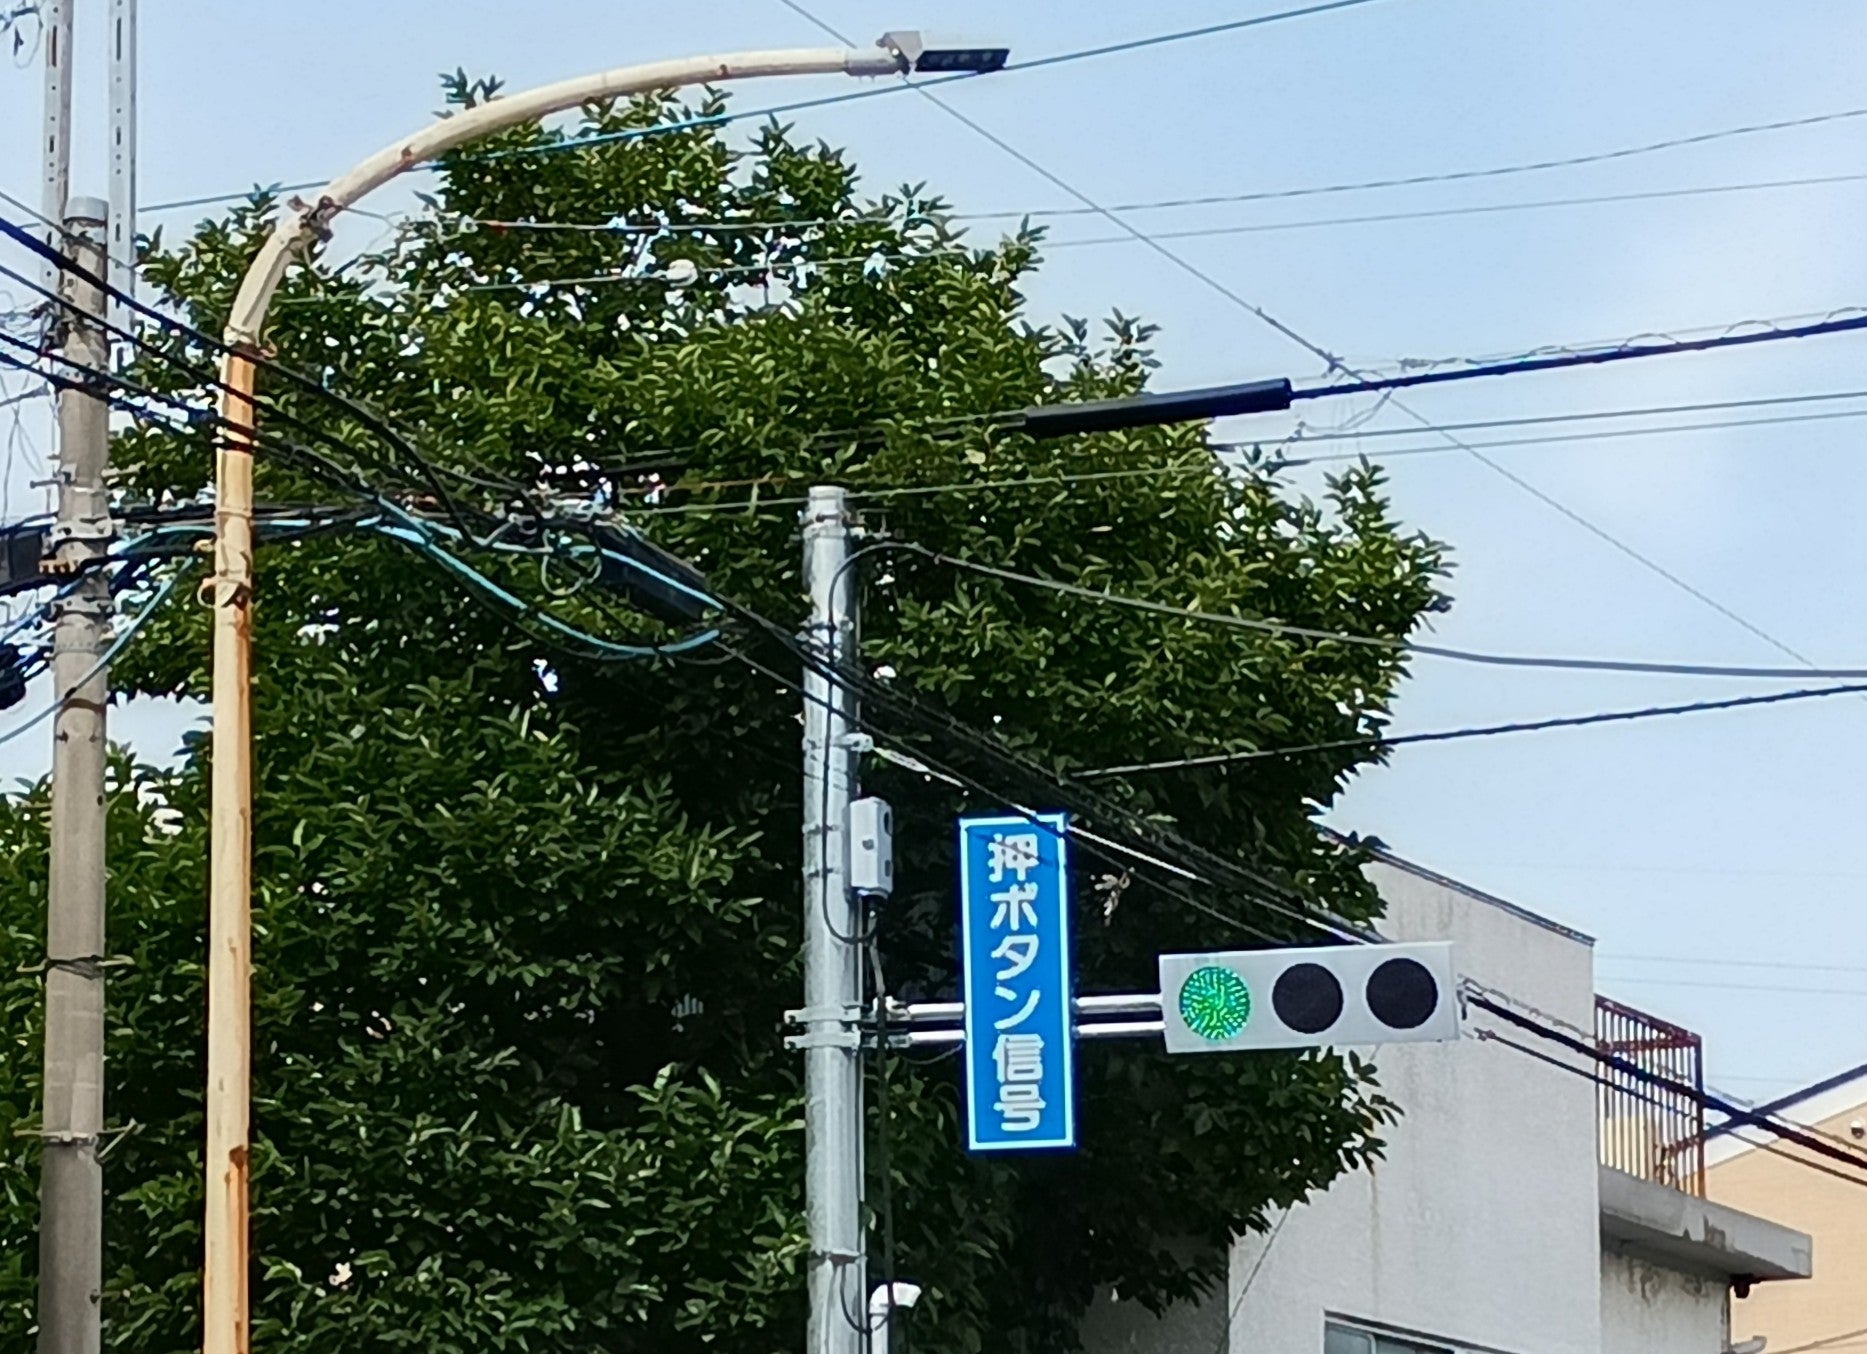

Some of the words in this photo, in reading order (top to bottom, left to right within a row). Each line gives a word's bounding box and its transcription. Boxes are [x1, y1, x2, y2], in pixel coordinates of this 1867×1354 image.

[988, 833, 1046, 1131] 押ボタン信号
